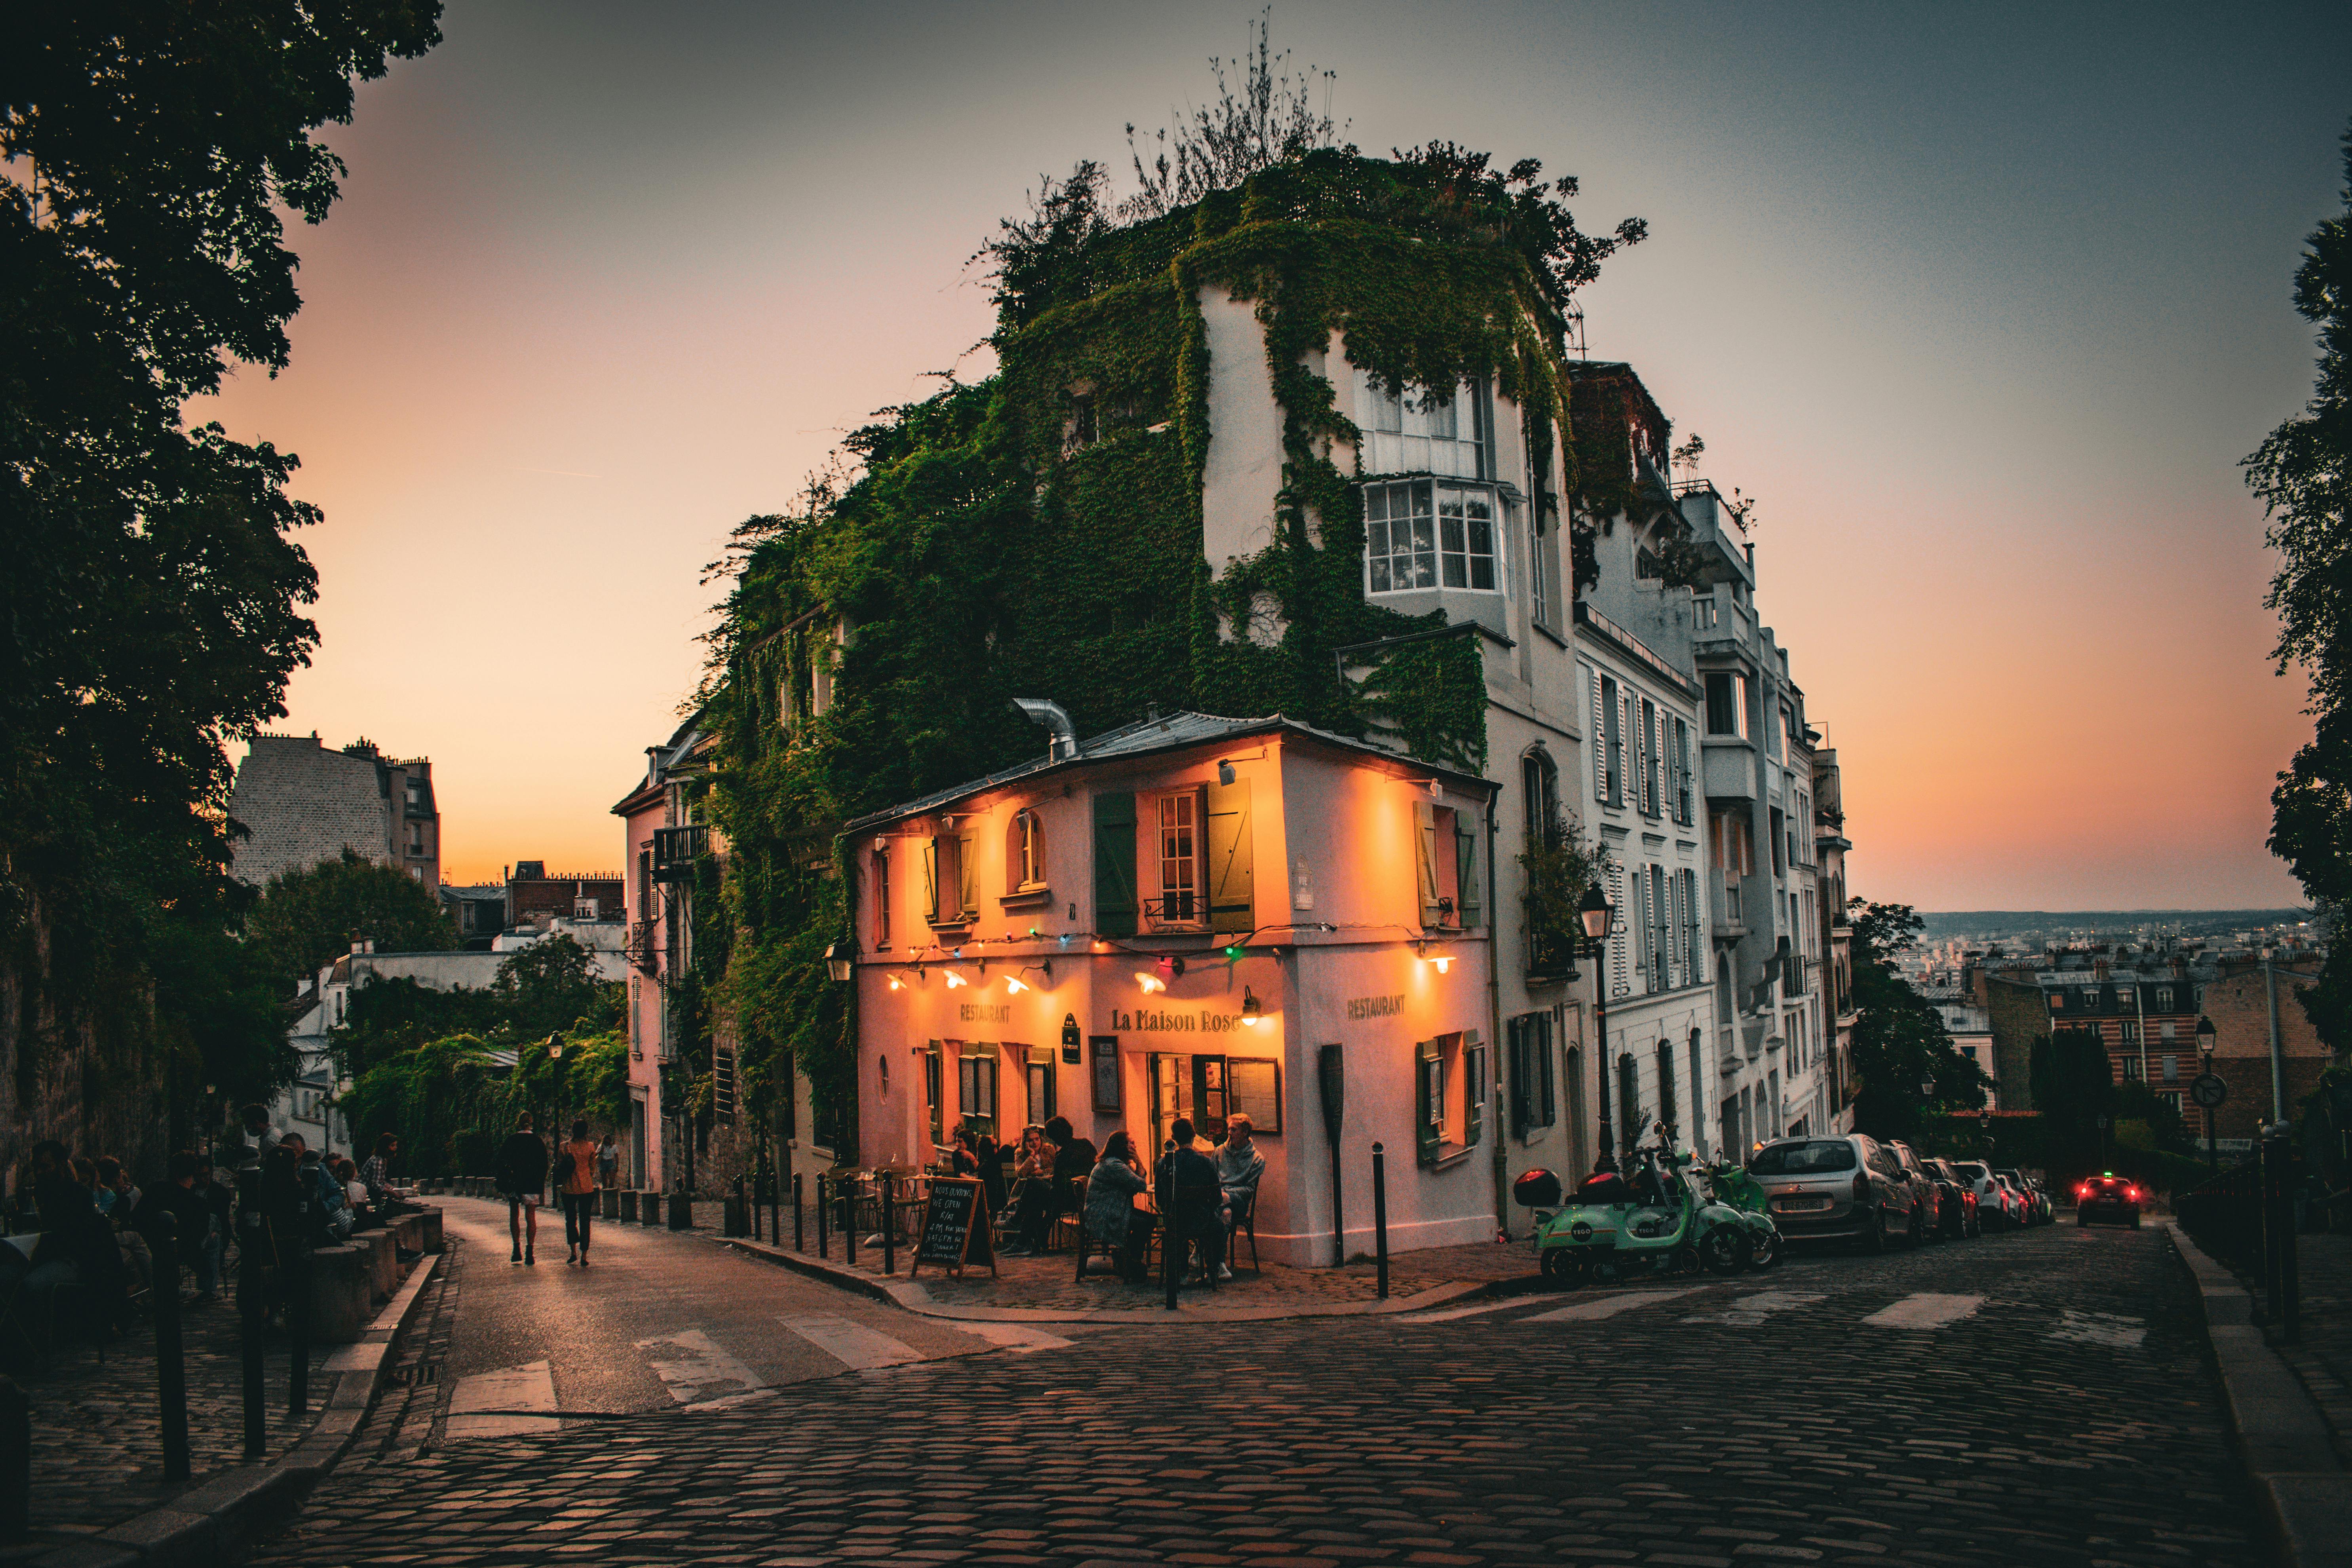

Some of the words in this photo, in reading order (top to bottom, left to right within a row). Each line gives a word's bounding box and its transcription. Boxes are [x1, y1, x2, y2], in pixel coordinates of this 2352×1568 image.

[1299, 876, 1307, 886] RUE
[960, 1004, 1010, 1024] RESTAURANT
[1347, 995, 1405, 1021] RESTAURANT
[1112, 1009, 1131, 1030] La
[1135, 1010, 1195, 1032] Maison
[1200, 1011, 1240, 1032] Rose
[935, 1186, 949, 1195] NOUS
[933, 1198, 943, 1207] WE
[945, 1199, 961, 1209] OPEN
